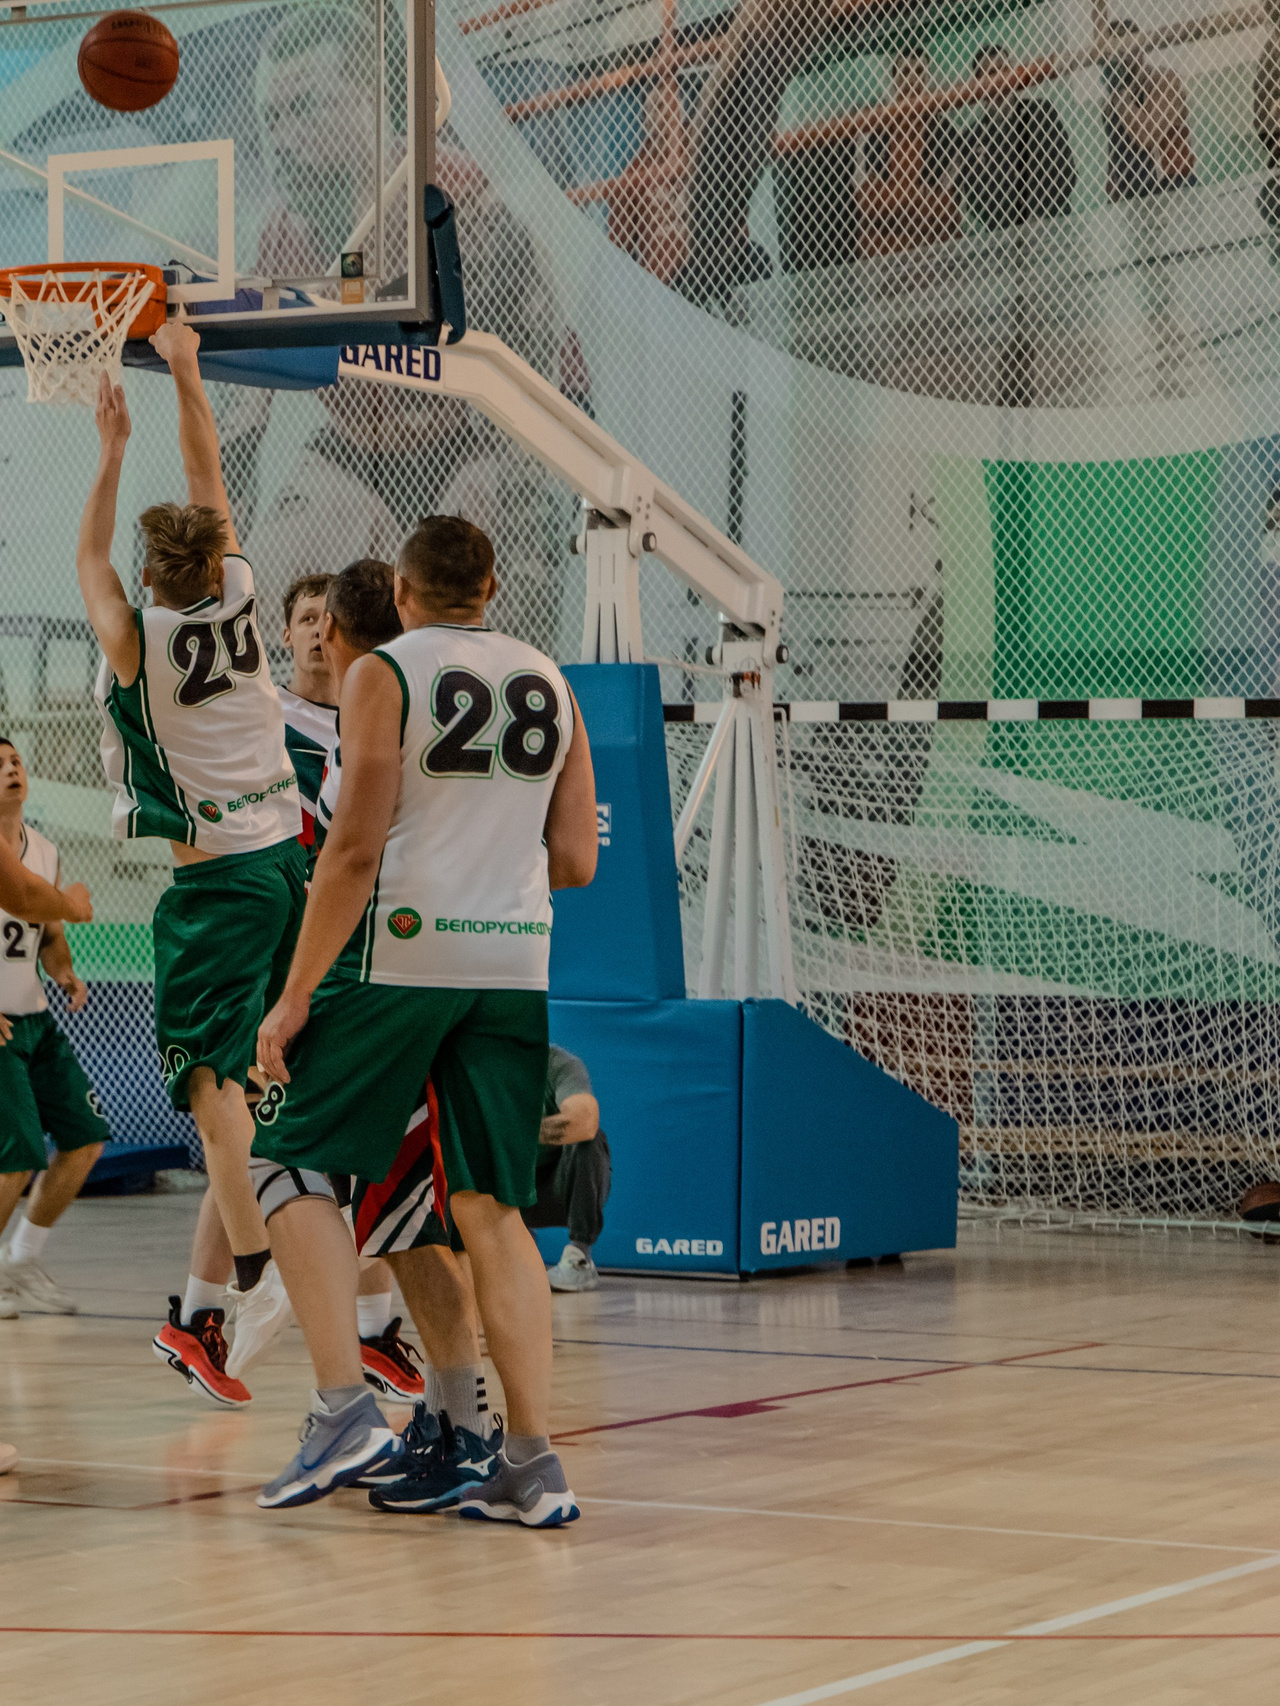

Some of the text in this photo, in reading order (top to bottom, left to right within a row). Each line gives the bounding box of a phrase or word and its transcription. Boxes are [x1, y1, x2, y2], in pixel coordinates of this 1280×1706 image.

[340, 344, 441, 382] GARED
[168, 595, 261, 708] 20
[420, 665, 562, 782] 28
[255, 1081, 287, 1126] 8
[635, 1237, 724, 1256] GARED
[760, 1216, 841, 1256] GARED
